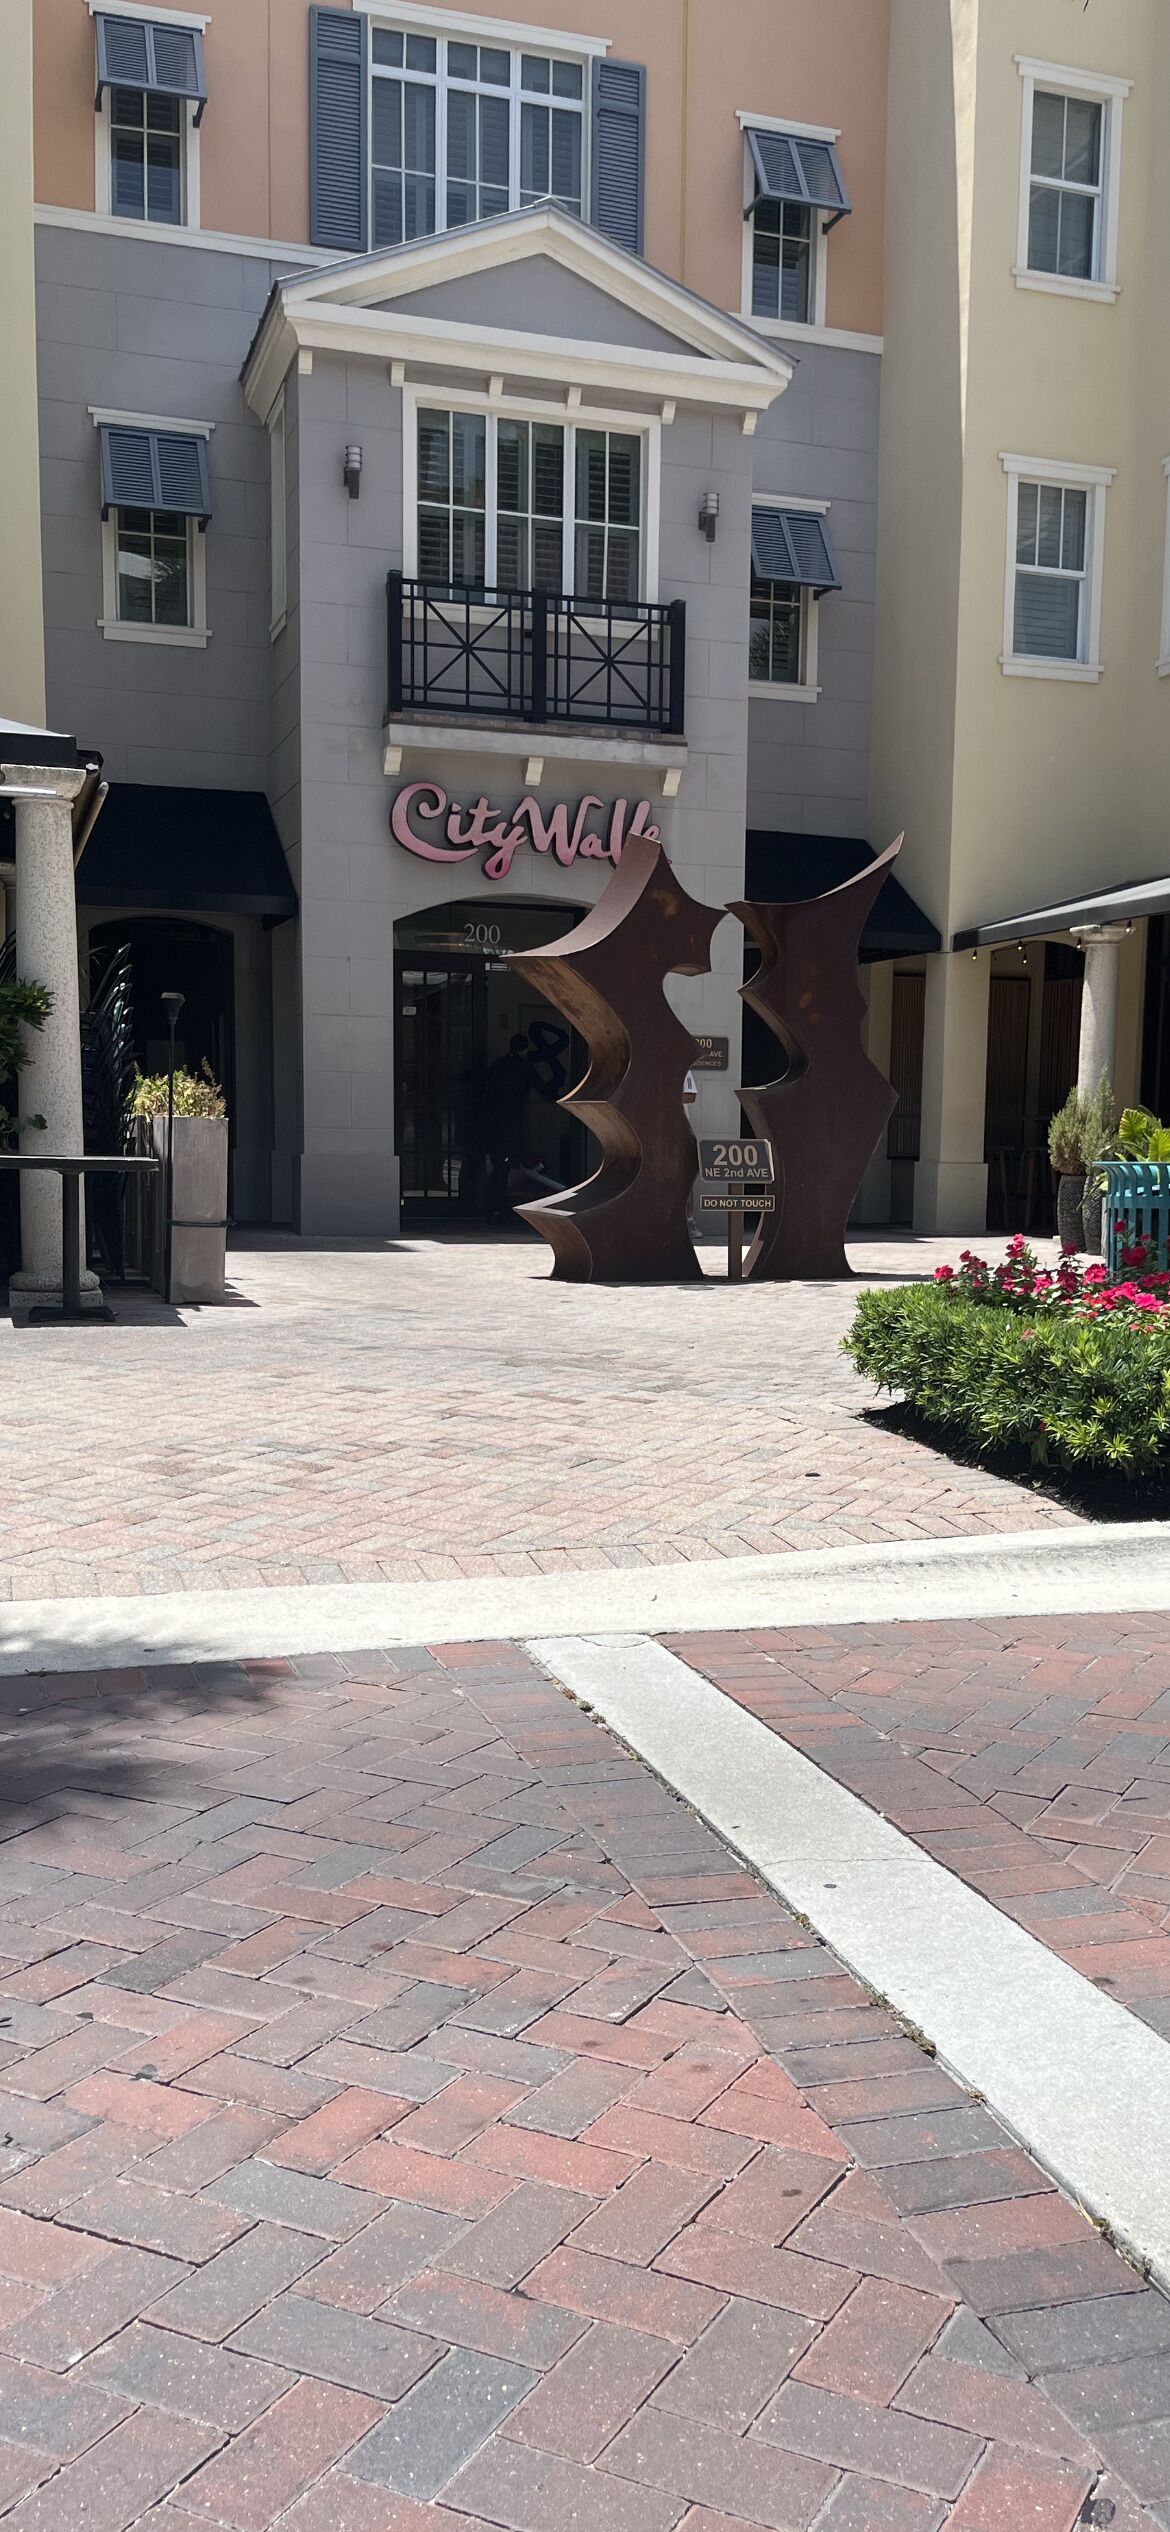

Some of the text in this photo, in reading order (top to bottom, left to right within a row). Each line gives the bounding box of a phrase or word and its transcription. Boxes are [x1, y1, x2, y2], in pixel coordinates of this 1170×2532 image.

[464, 924, 500, 943] 200
[695, 1039, 712, 1048] 00
[712, 1144, 758, 1166] 200
[705, 1168, 769, 1178] NE 2nd AVE
[704, 1199, 771, 1208] DO NOT TOUCH
